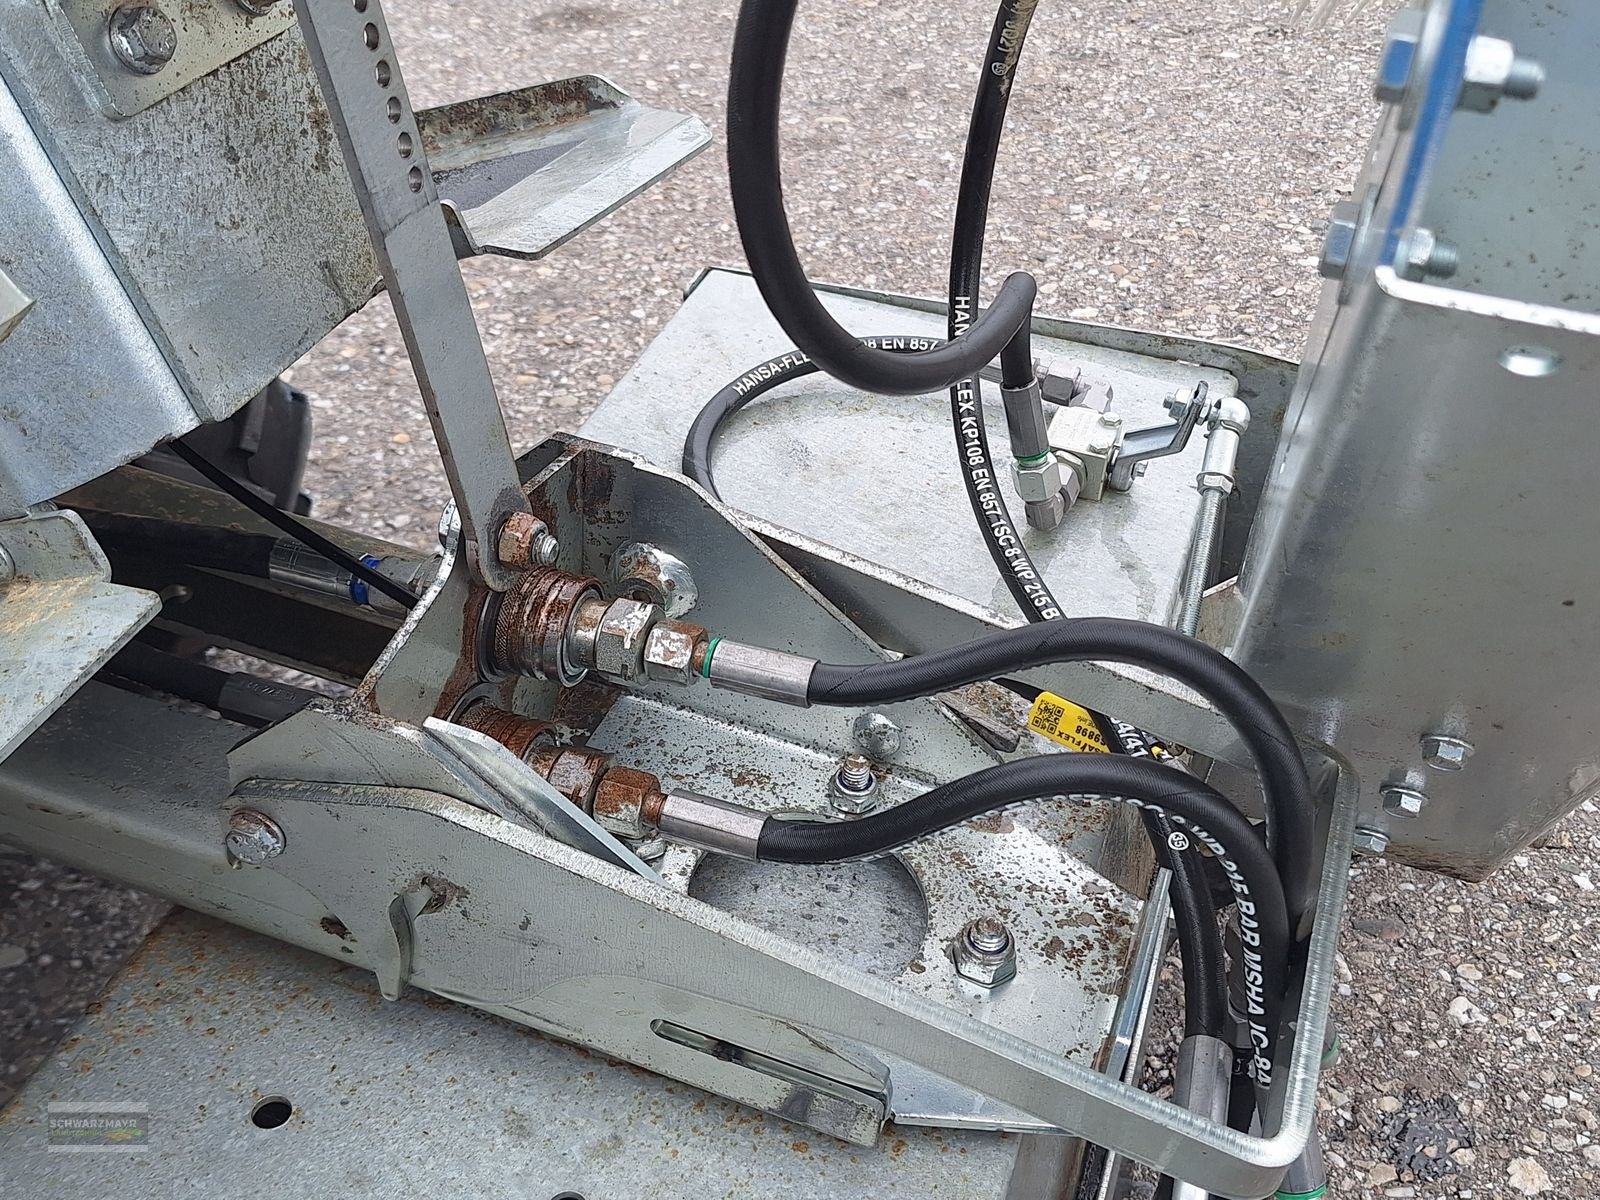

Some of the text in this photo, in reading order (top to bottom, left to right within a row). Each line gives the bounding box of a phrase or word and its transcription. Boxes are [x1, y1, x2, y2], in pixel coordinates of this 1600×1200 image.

[881, 338, 904, 350] EN
[909, 339, 940, 350] 857
[957, 379, 976, 413] LEX
[960, 416, 985, 466] KP108
[971, 468, 993, 492] EN
[980, 492, 1004, 517] 857
[991, 518, 1016, 547] 1SC
[1004, 548, 1021, 559] 8
[1011, 557, 1036, 580] WP
[1024, 581, 1050, 607] 215
[1171, 833, 1186, 849] 35
[1235, 896, 1260, 947] BAR
[1242, 946, 1264, 1015] MSHA
